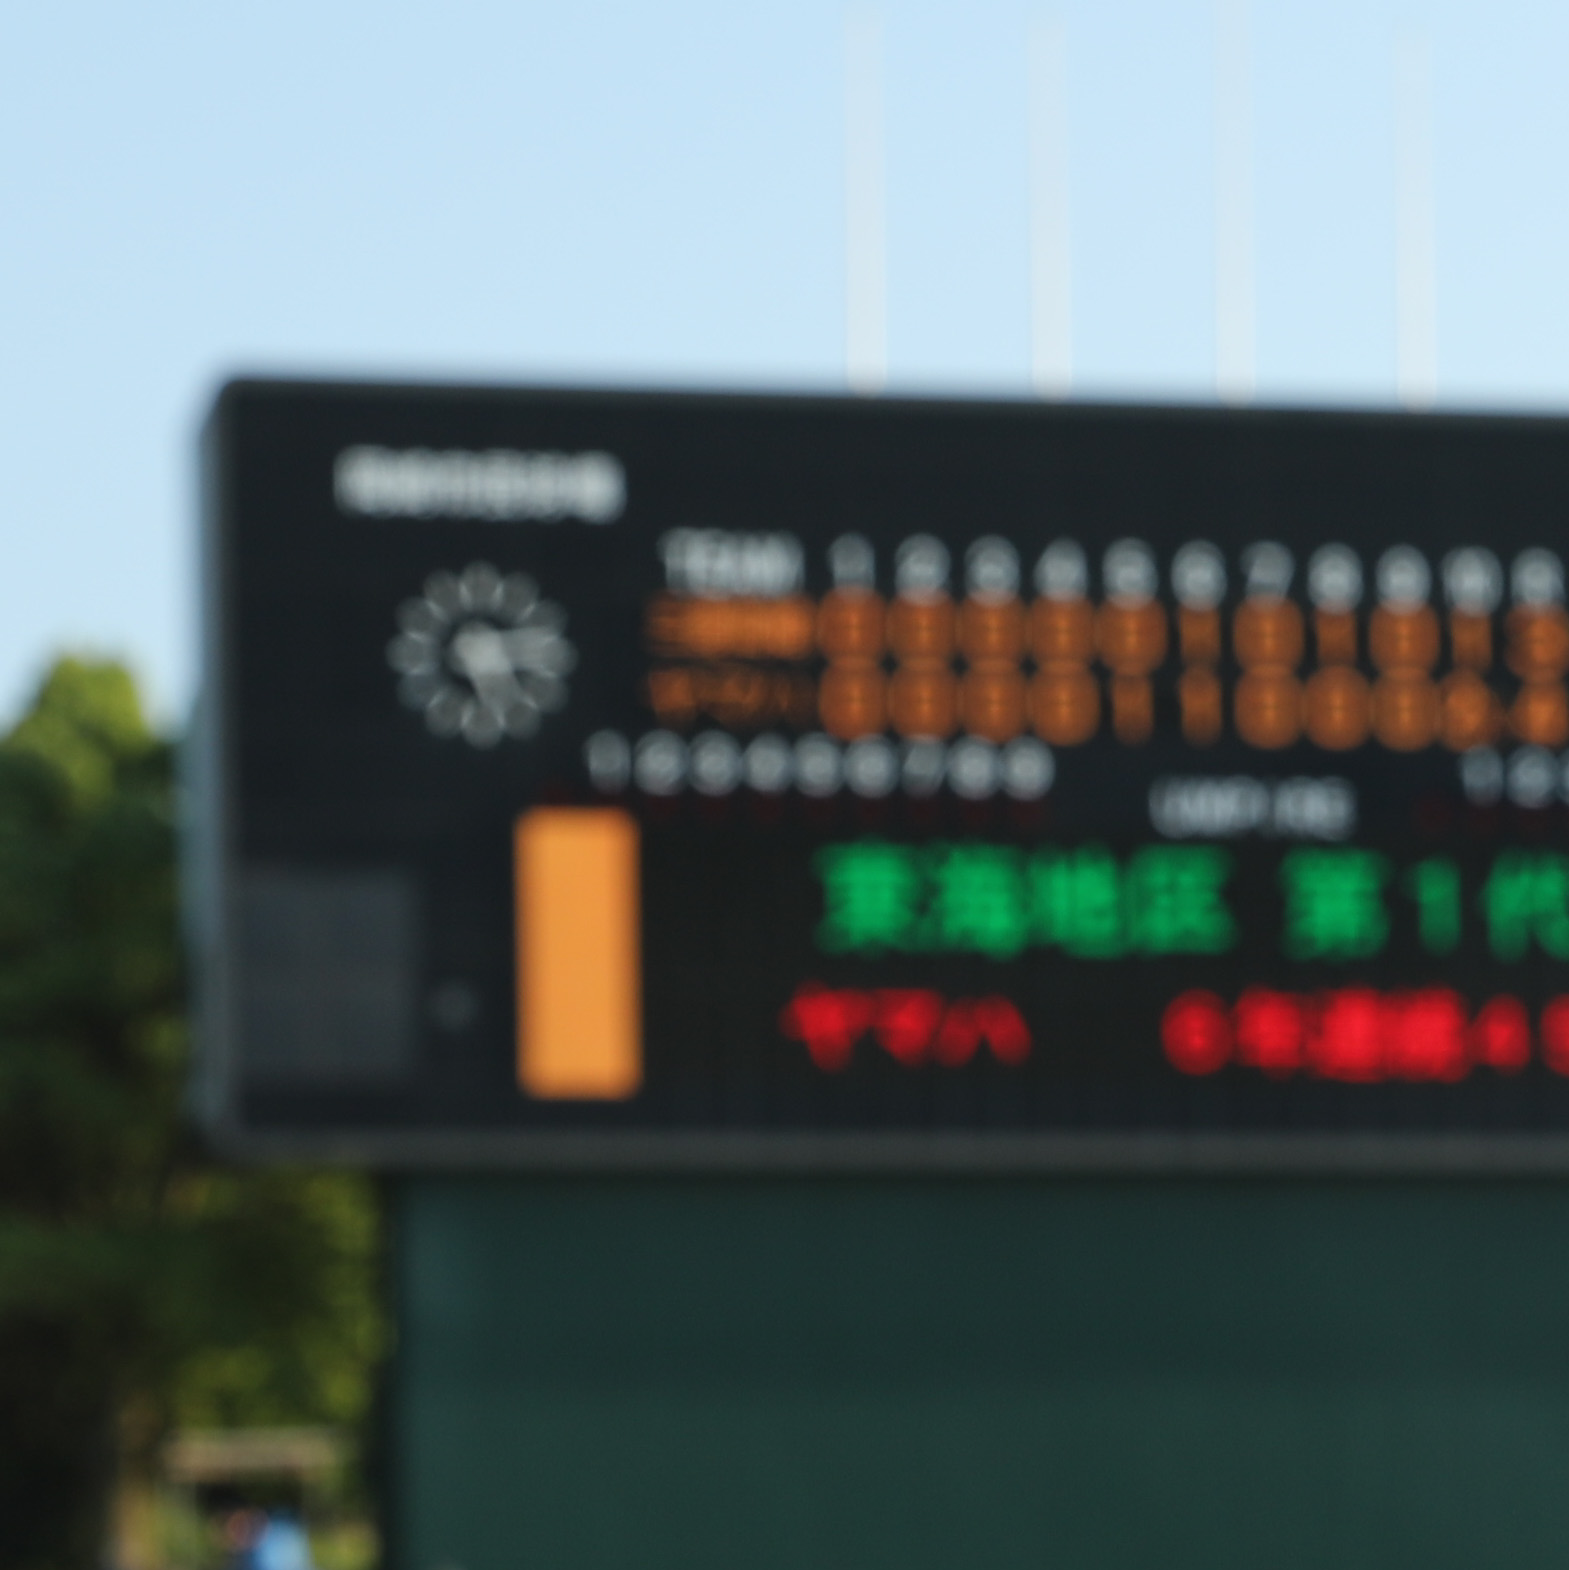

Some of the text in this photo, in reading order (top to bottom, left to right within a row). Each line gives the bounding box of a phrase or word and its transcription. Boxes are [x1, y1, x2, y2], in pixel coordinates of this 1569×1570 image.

[820, 843, 1232, 957] 東海地区
[786, 985, 1030, 1066] ヤマハ
